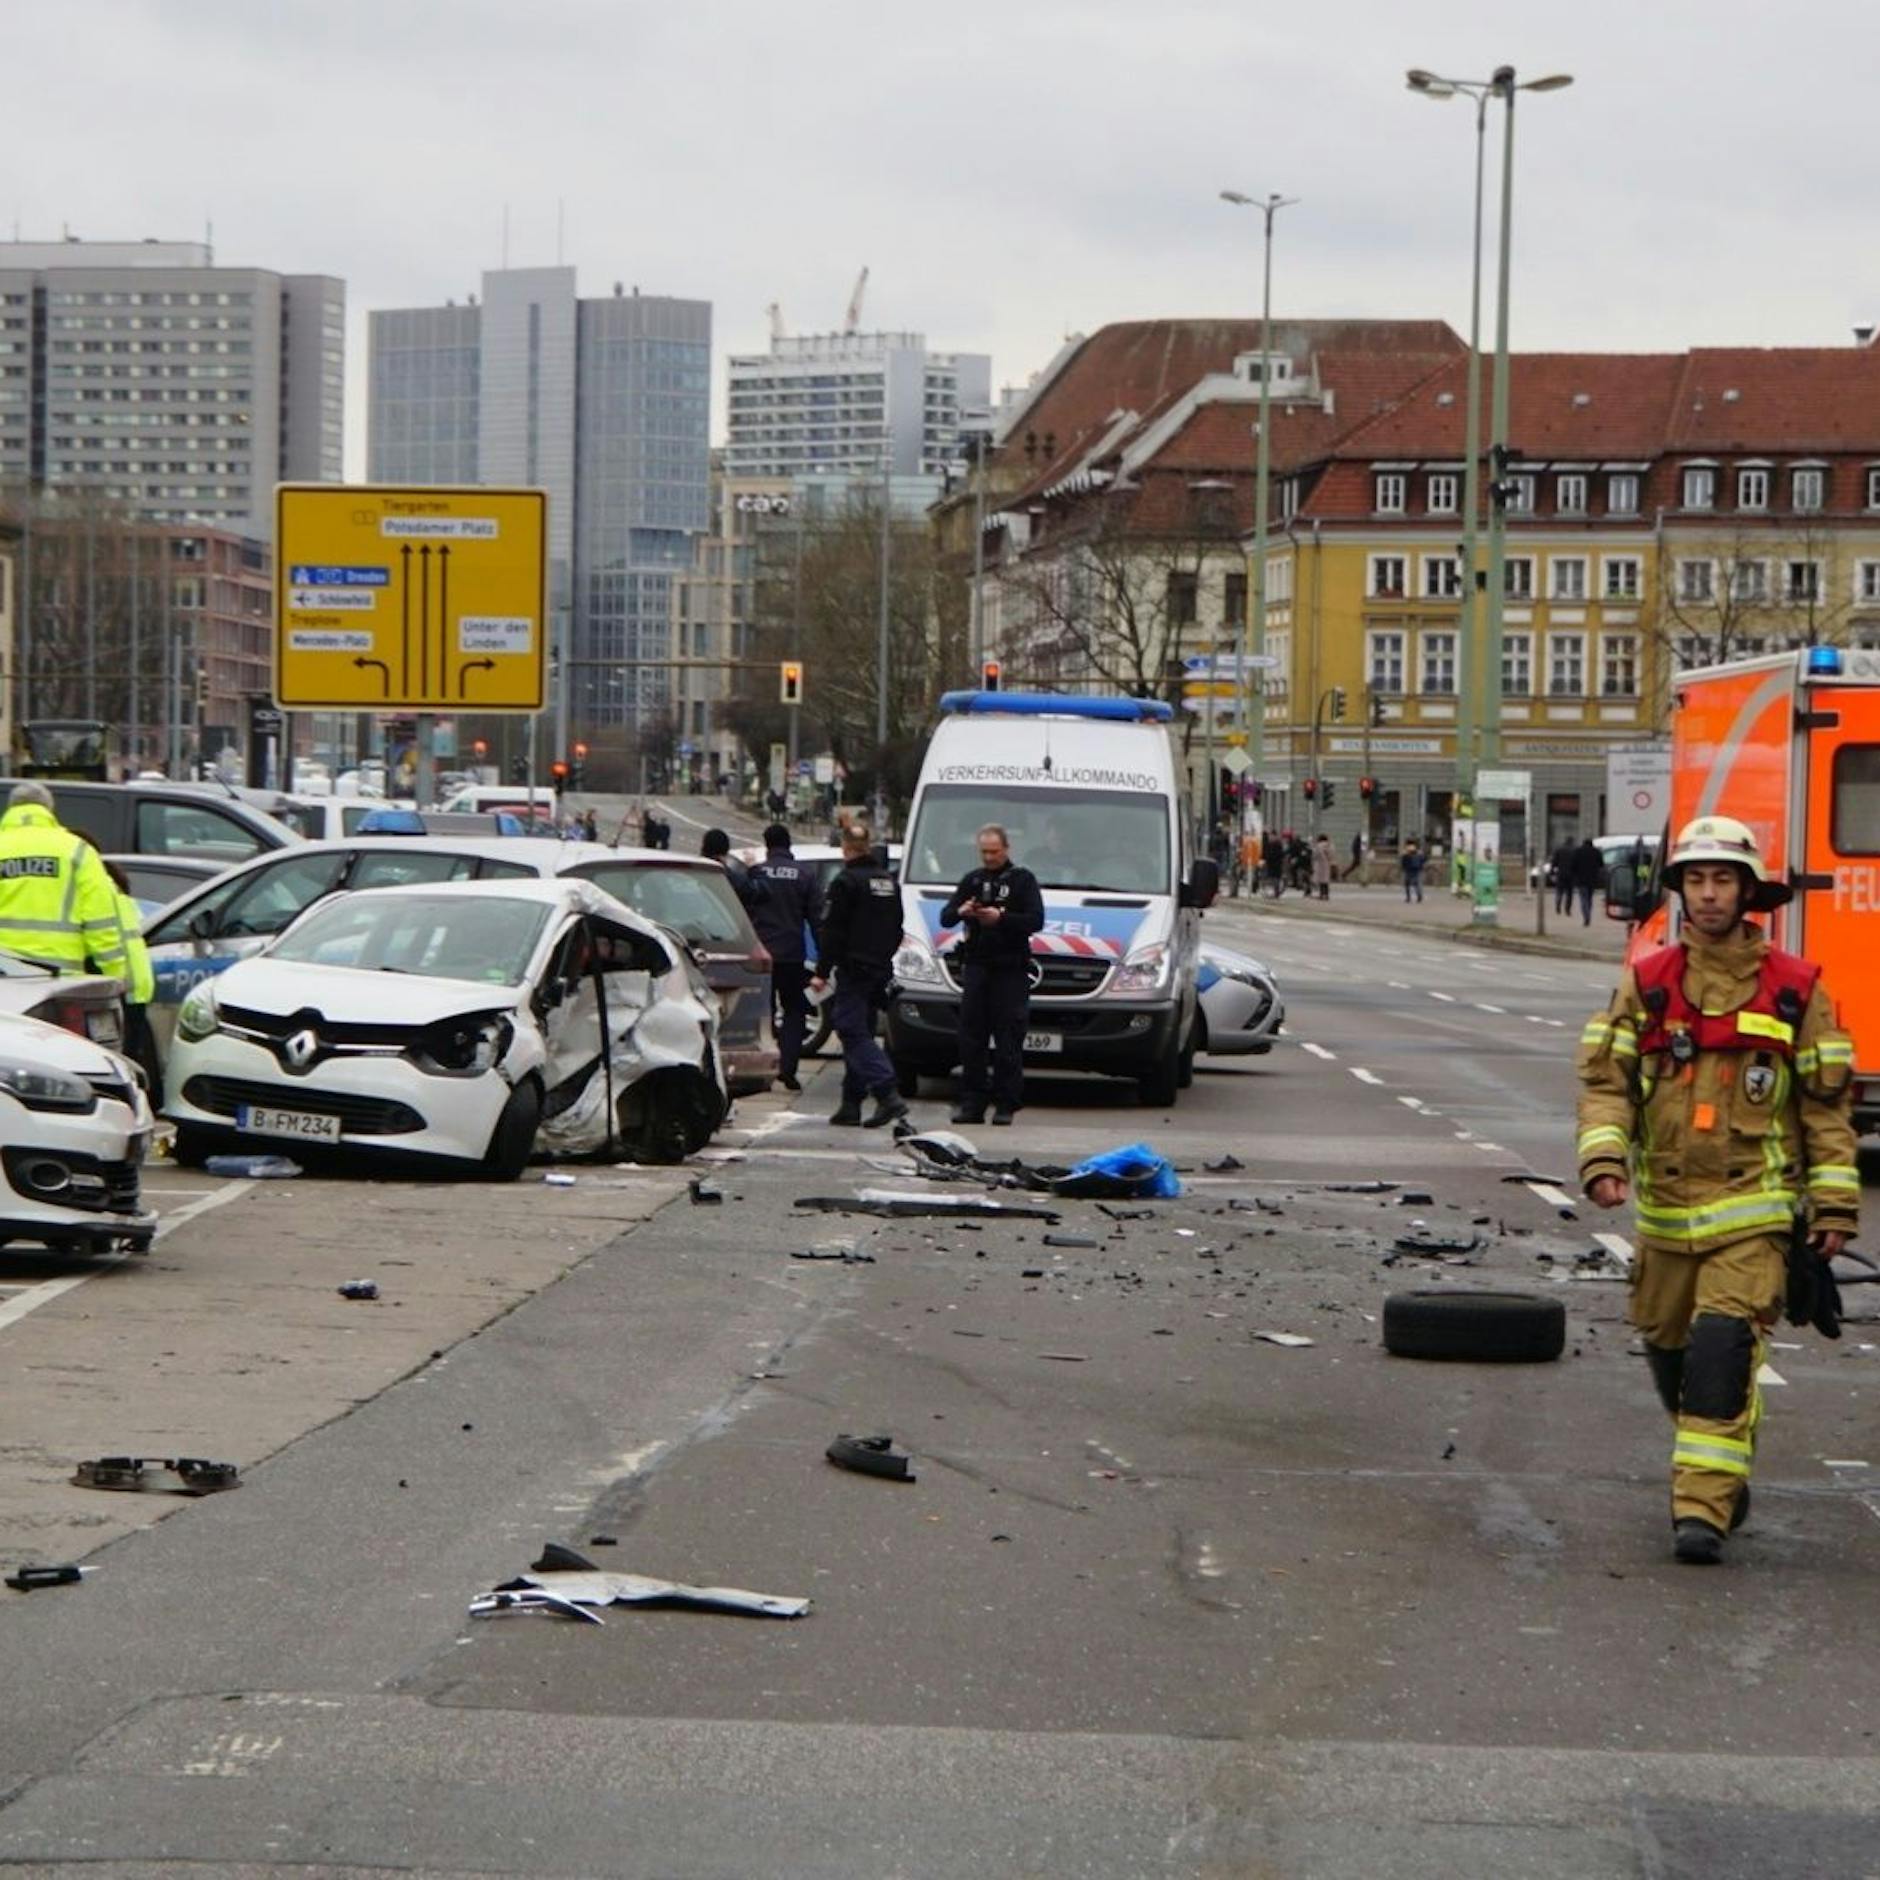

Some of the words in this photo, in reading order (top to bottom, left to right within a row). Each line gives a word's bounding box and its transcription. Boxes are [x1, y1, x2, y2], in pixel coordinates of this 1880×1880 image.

[385, 520, 455, 534] Potsdamer
[461, 522, 494, 535] Platz
[463, 620, 499, 634] Unter
[505, 622, 529, 634] den
[463, 637, 507, 650] Linden
[937, 764, 1159, 791] VERKEHRSUNFALLKOMMANDO
[175, 968, 214, 994] PO
[254, 1110, 266, 1127] B
[301, 1116, 333, 1135] 234
